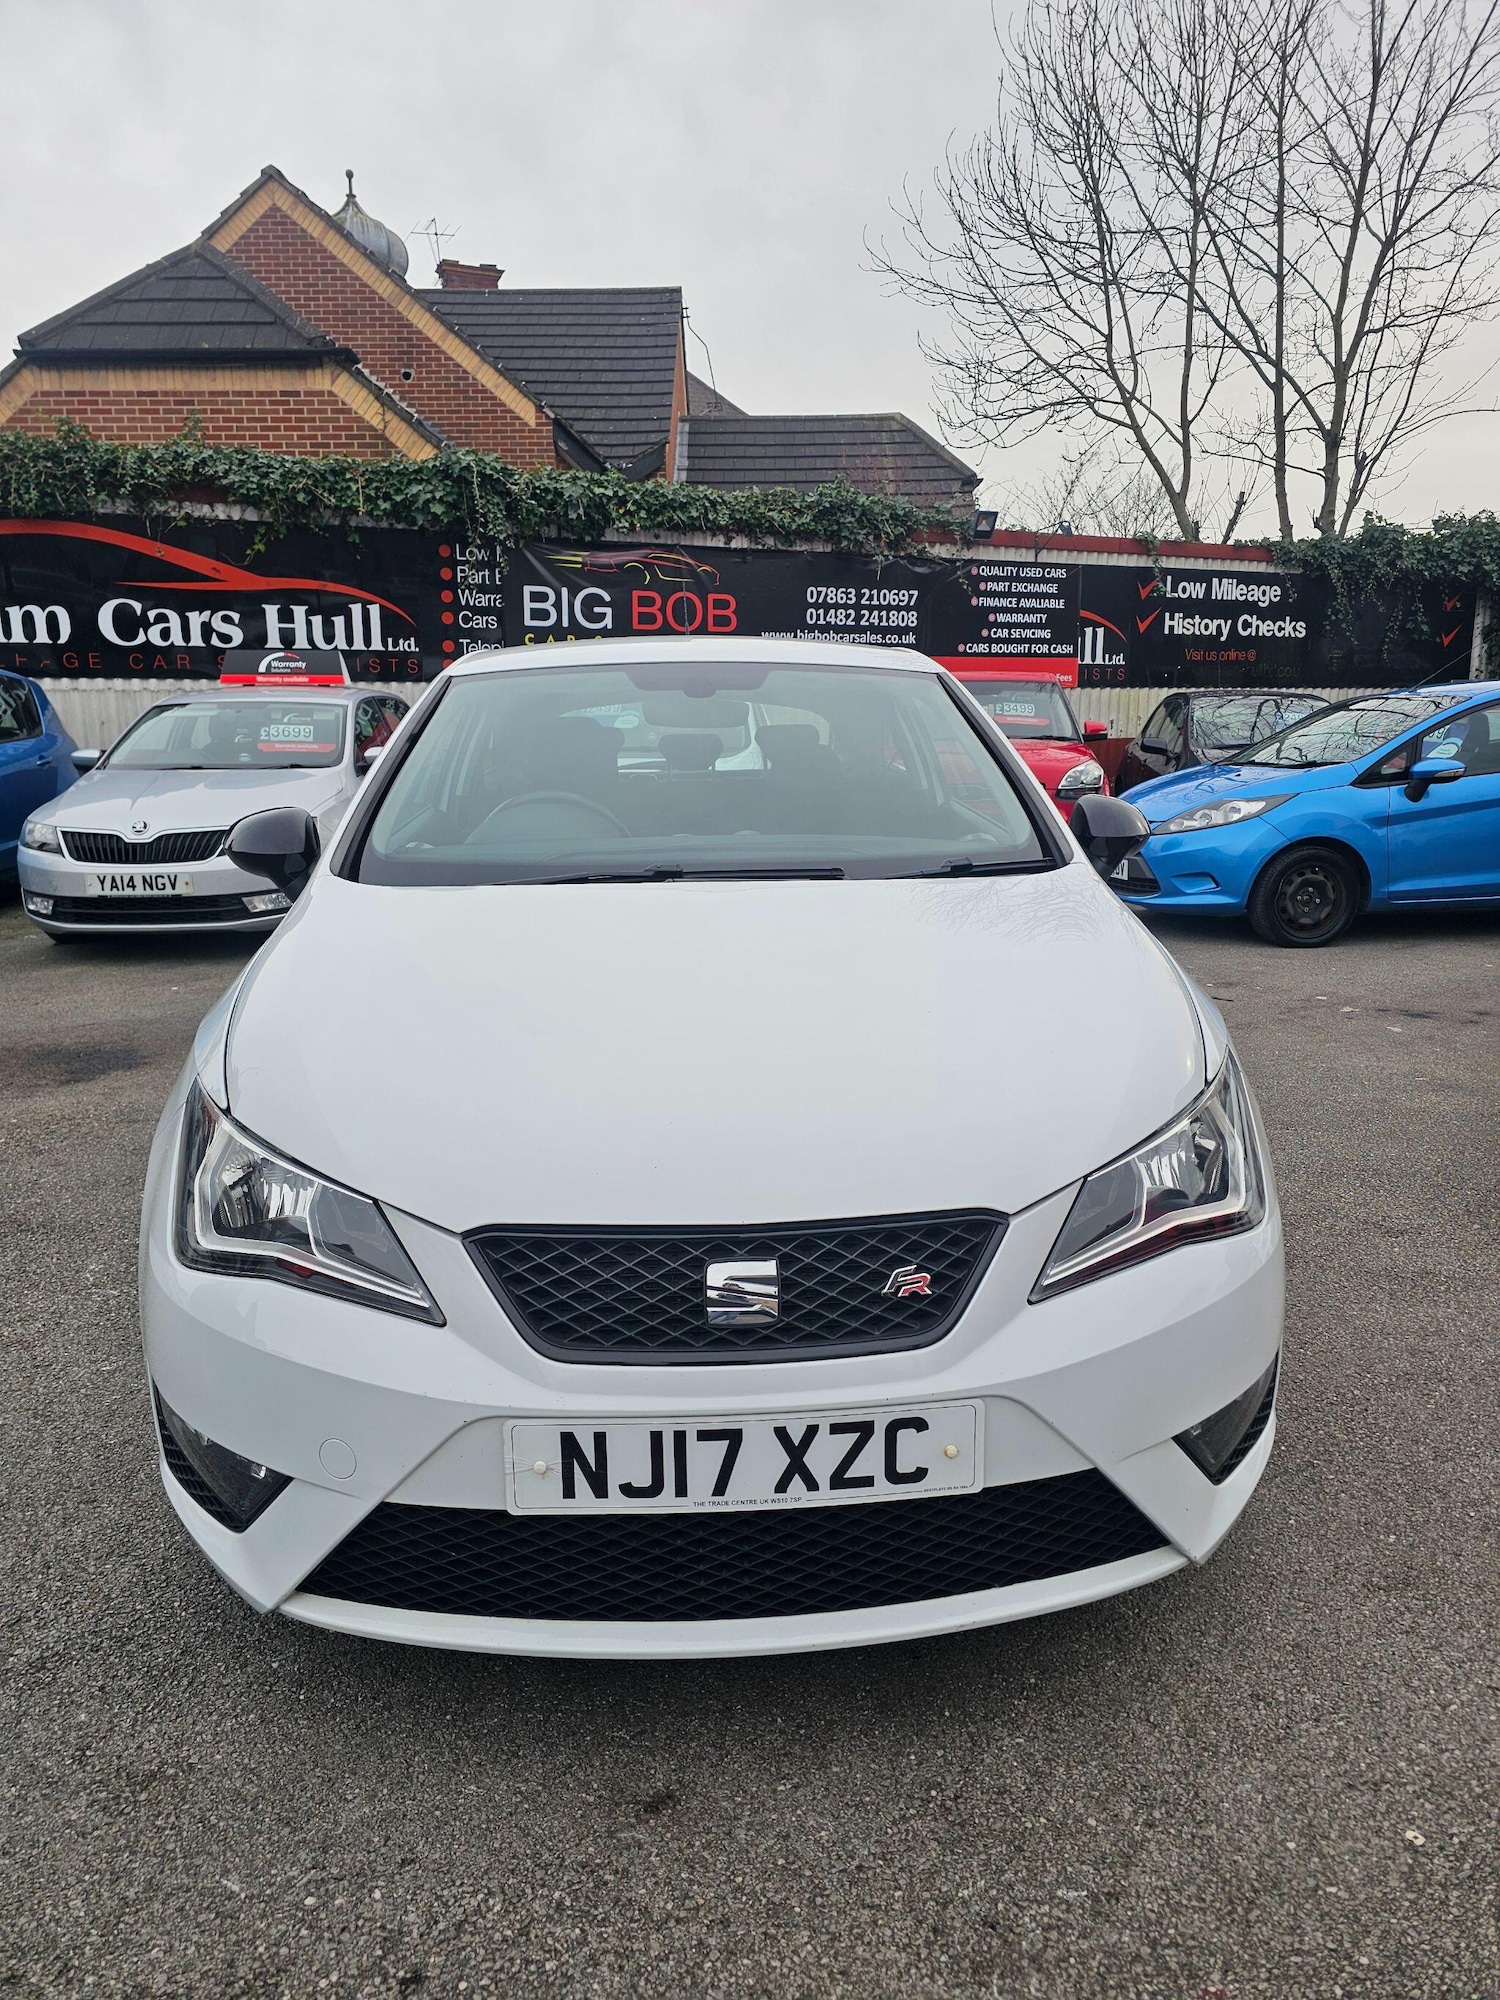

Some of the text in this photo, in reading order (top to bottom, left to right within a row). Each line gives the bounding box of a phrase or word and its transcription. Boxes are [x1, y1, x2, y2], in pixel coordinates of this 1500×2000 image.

[980, 566, 1066, 578] QUALITY USED CARS
[987, 582, 1058, 593] PART EXCHANGE
[1166, 575, 1281, 607] Low Mileage
[806, 586, 918, 606] 07863 210697
[979, 597, 1065, 609] FINANCE AVALIABLE
[523, 585, 737, 633] BIG BOB
[98, 598, 244, 647] Cars
[262, 603, 386, 650] Hull
[387, 637, 419, 652] Ltd.
[458, 611, 497, 629] Cars
[806, 608, 917, 627] 01482 241808
[997, 613, 1047, 624] WARRANTY
[991, 628, 1051, 639] CAR SEVICING
[1164, 612, 1306, 642] History Checks
[761, 628, 916, 645] wwwbigbobcarsales.co.uk
[966, 643, 1073, 654] CARS BOUGHT FOR CASH
[1185, 648, 1203, 661] Visit
[1206, 651, 1217, 661] us
[1220, 650, 1246, 661] online
[129, 653, 190, 669] CAR
[270, 660, 307, 669] Warranty
[1105, 653, 1125, 665] Ltd.
[260, 726, 313, 740] £3699
[97, 874, 177, 891] YA14 NGV
[559, 1416, 929, 1499] NJ17 XZC
[731, 1499, 758, 1507] CENTRE
